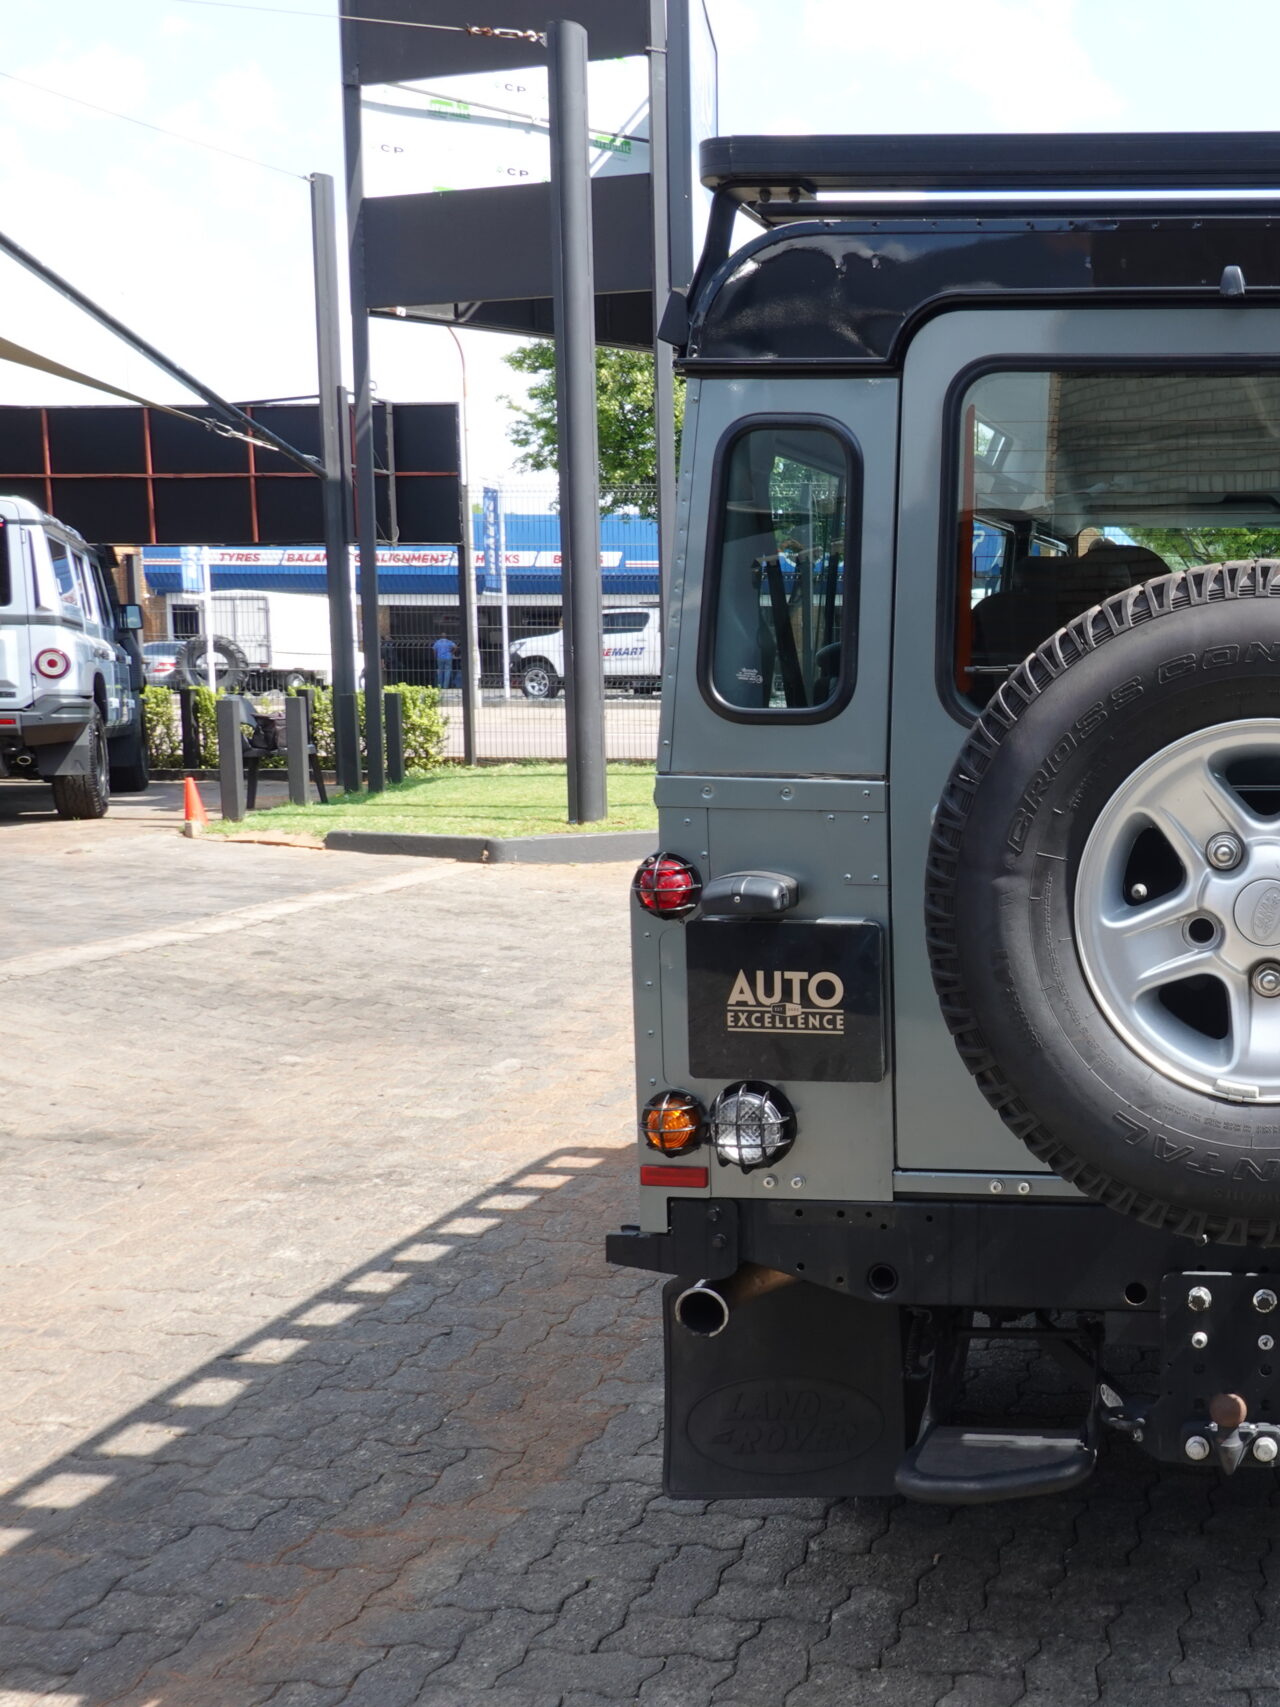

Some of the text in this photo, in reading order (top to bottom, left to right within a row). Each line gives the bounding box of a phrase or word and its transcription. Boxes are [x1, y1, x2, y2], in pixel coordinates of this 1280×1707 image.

[219, 552, 261, 563] TYRES
[475, 554, 520, 564] HKS
[1006, 674, 1145, 854] CROSS
[727, 968, 845, 1008] AUTO
[727, 1011, 845, 1030] EXCELLENCE
